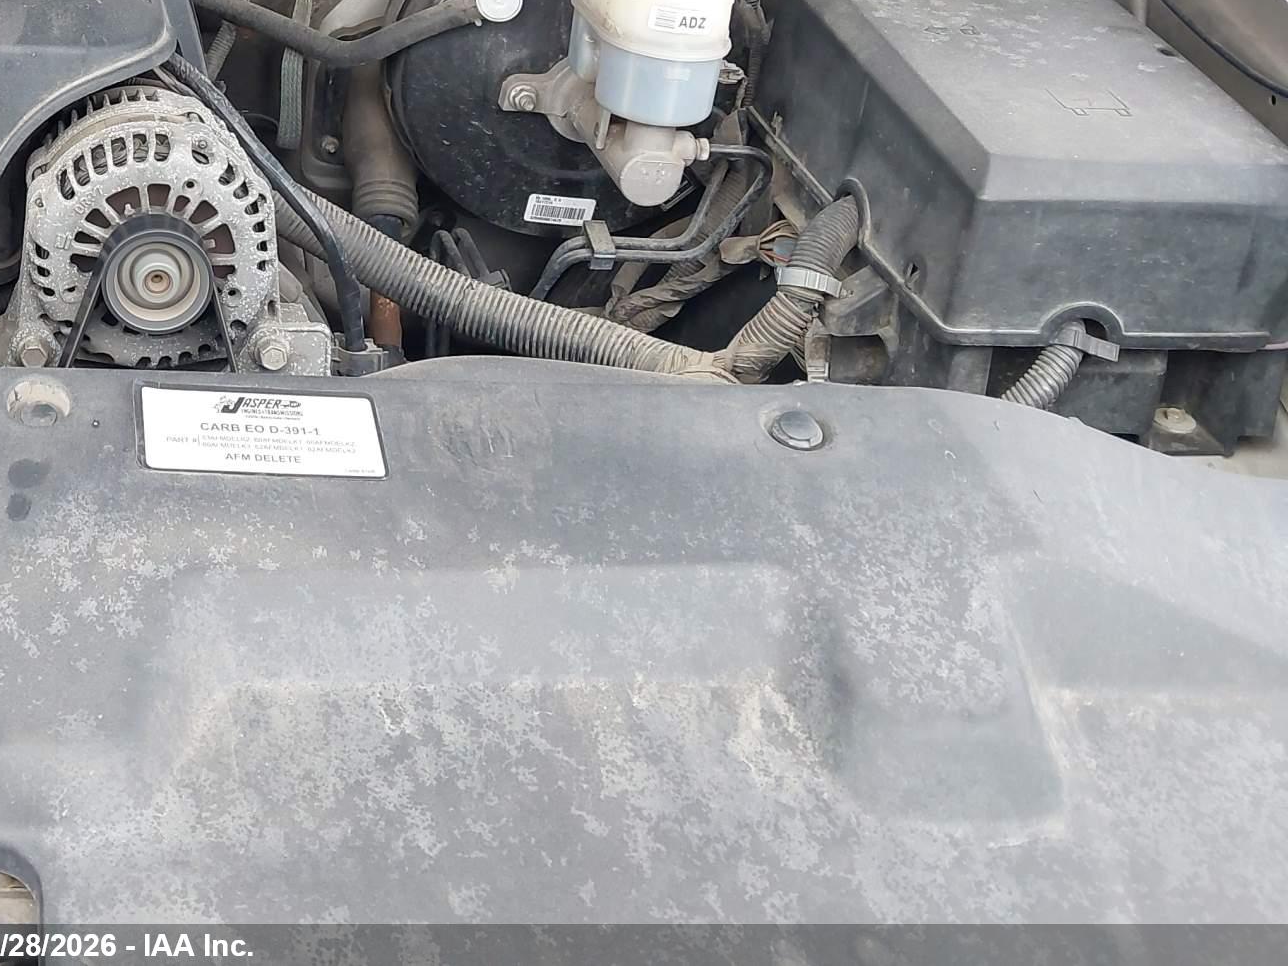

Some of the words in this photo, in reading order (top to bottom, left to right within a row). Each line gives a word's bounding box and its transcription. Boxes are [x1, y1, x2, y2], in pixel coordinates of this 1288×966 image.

[678, 16, 706, 29] ADZ
[221, 396, 282, 414] JASPER
[200, 422, 240, 432] CARB
[245, 424, 265, 434] EO
[269, 425, 320, 436] D-391-1
[225, 452, 251, 461] AFM
[254, 454, 302, 464] DELETE
